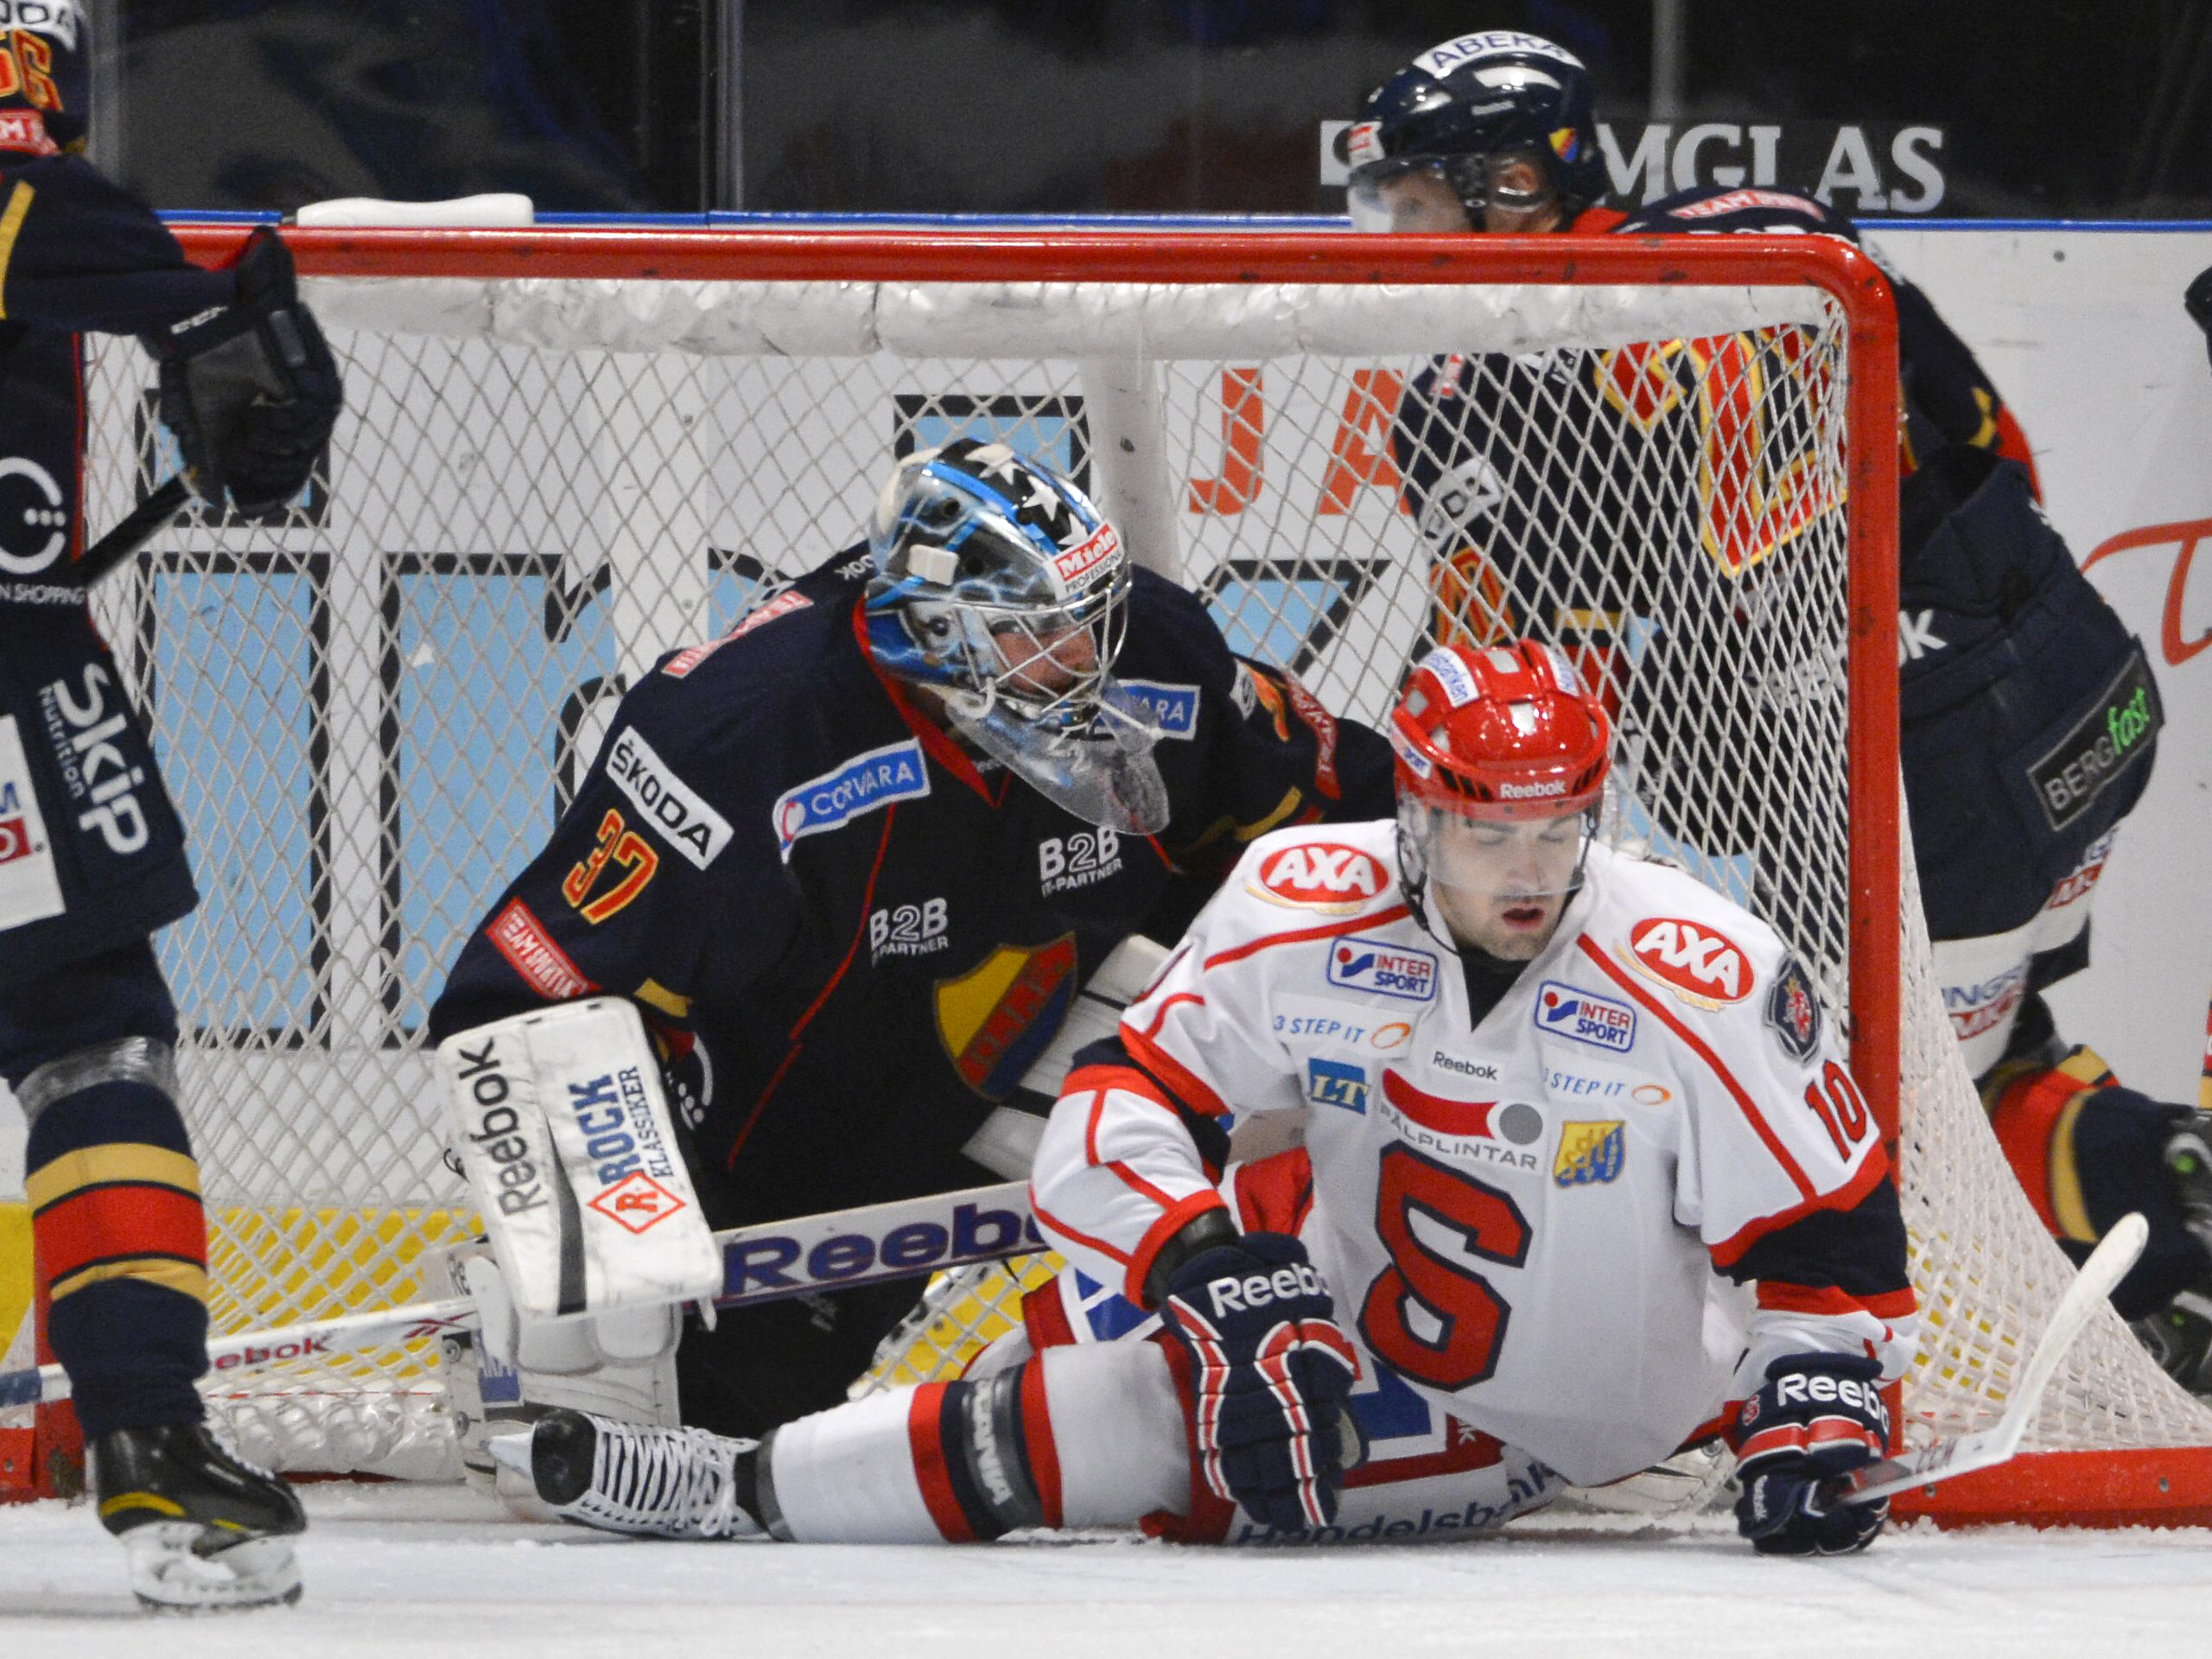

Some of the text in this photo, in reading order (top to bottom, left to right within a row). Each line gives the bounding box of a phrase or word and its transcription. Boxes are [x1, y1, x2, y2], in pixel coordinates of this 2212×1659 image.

[1057, 529, 1118, 579] Miele
[611, 741, 713, 857] ŠKODA
[810, 759, 915, 817] CORVARA
[1499, 779, 1567, 799] Reebok
[562, 808, 659, 925] 37
[1039, 824, 1120, 881] B2B
[1266, 846, 1377, 896] AXA
[869, 896, 948, 951] B2B
[1375, 970, 1429, 994] SPORT
[1376, 953, 1431, 977] INTER
[1634, 920, 1740, 998] AXA
[1273, 1014, 1365, 1043] 3 STEP IT
[1575, 1019, 1628, 1046] SPORT
[1580, 1001, 1630, 1029] INTER
[1311, 1075, 1370, 1107] LT
[1433, 1051, 1498, 1081] Reebok
[1550, 1072, 1601, 1096] STEP
[1604, 1082, 1626, 1096] IT
[459, 1036, 549, 1217] Reebok
[567, 1073, 645, 1185] ROCK
[618, 1065, 675, 1179] KLASSIKER
[1804, 1058, 1867, 1164] 10
